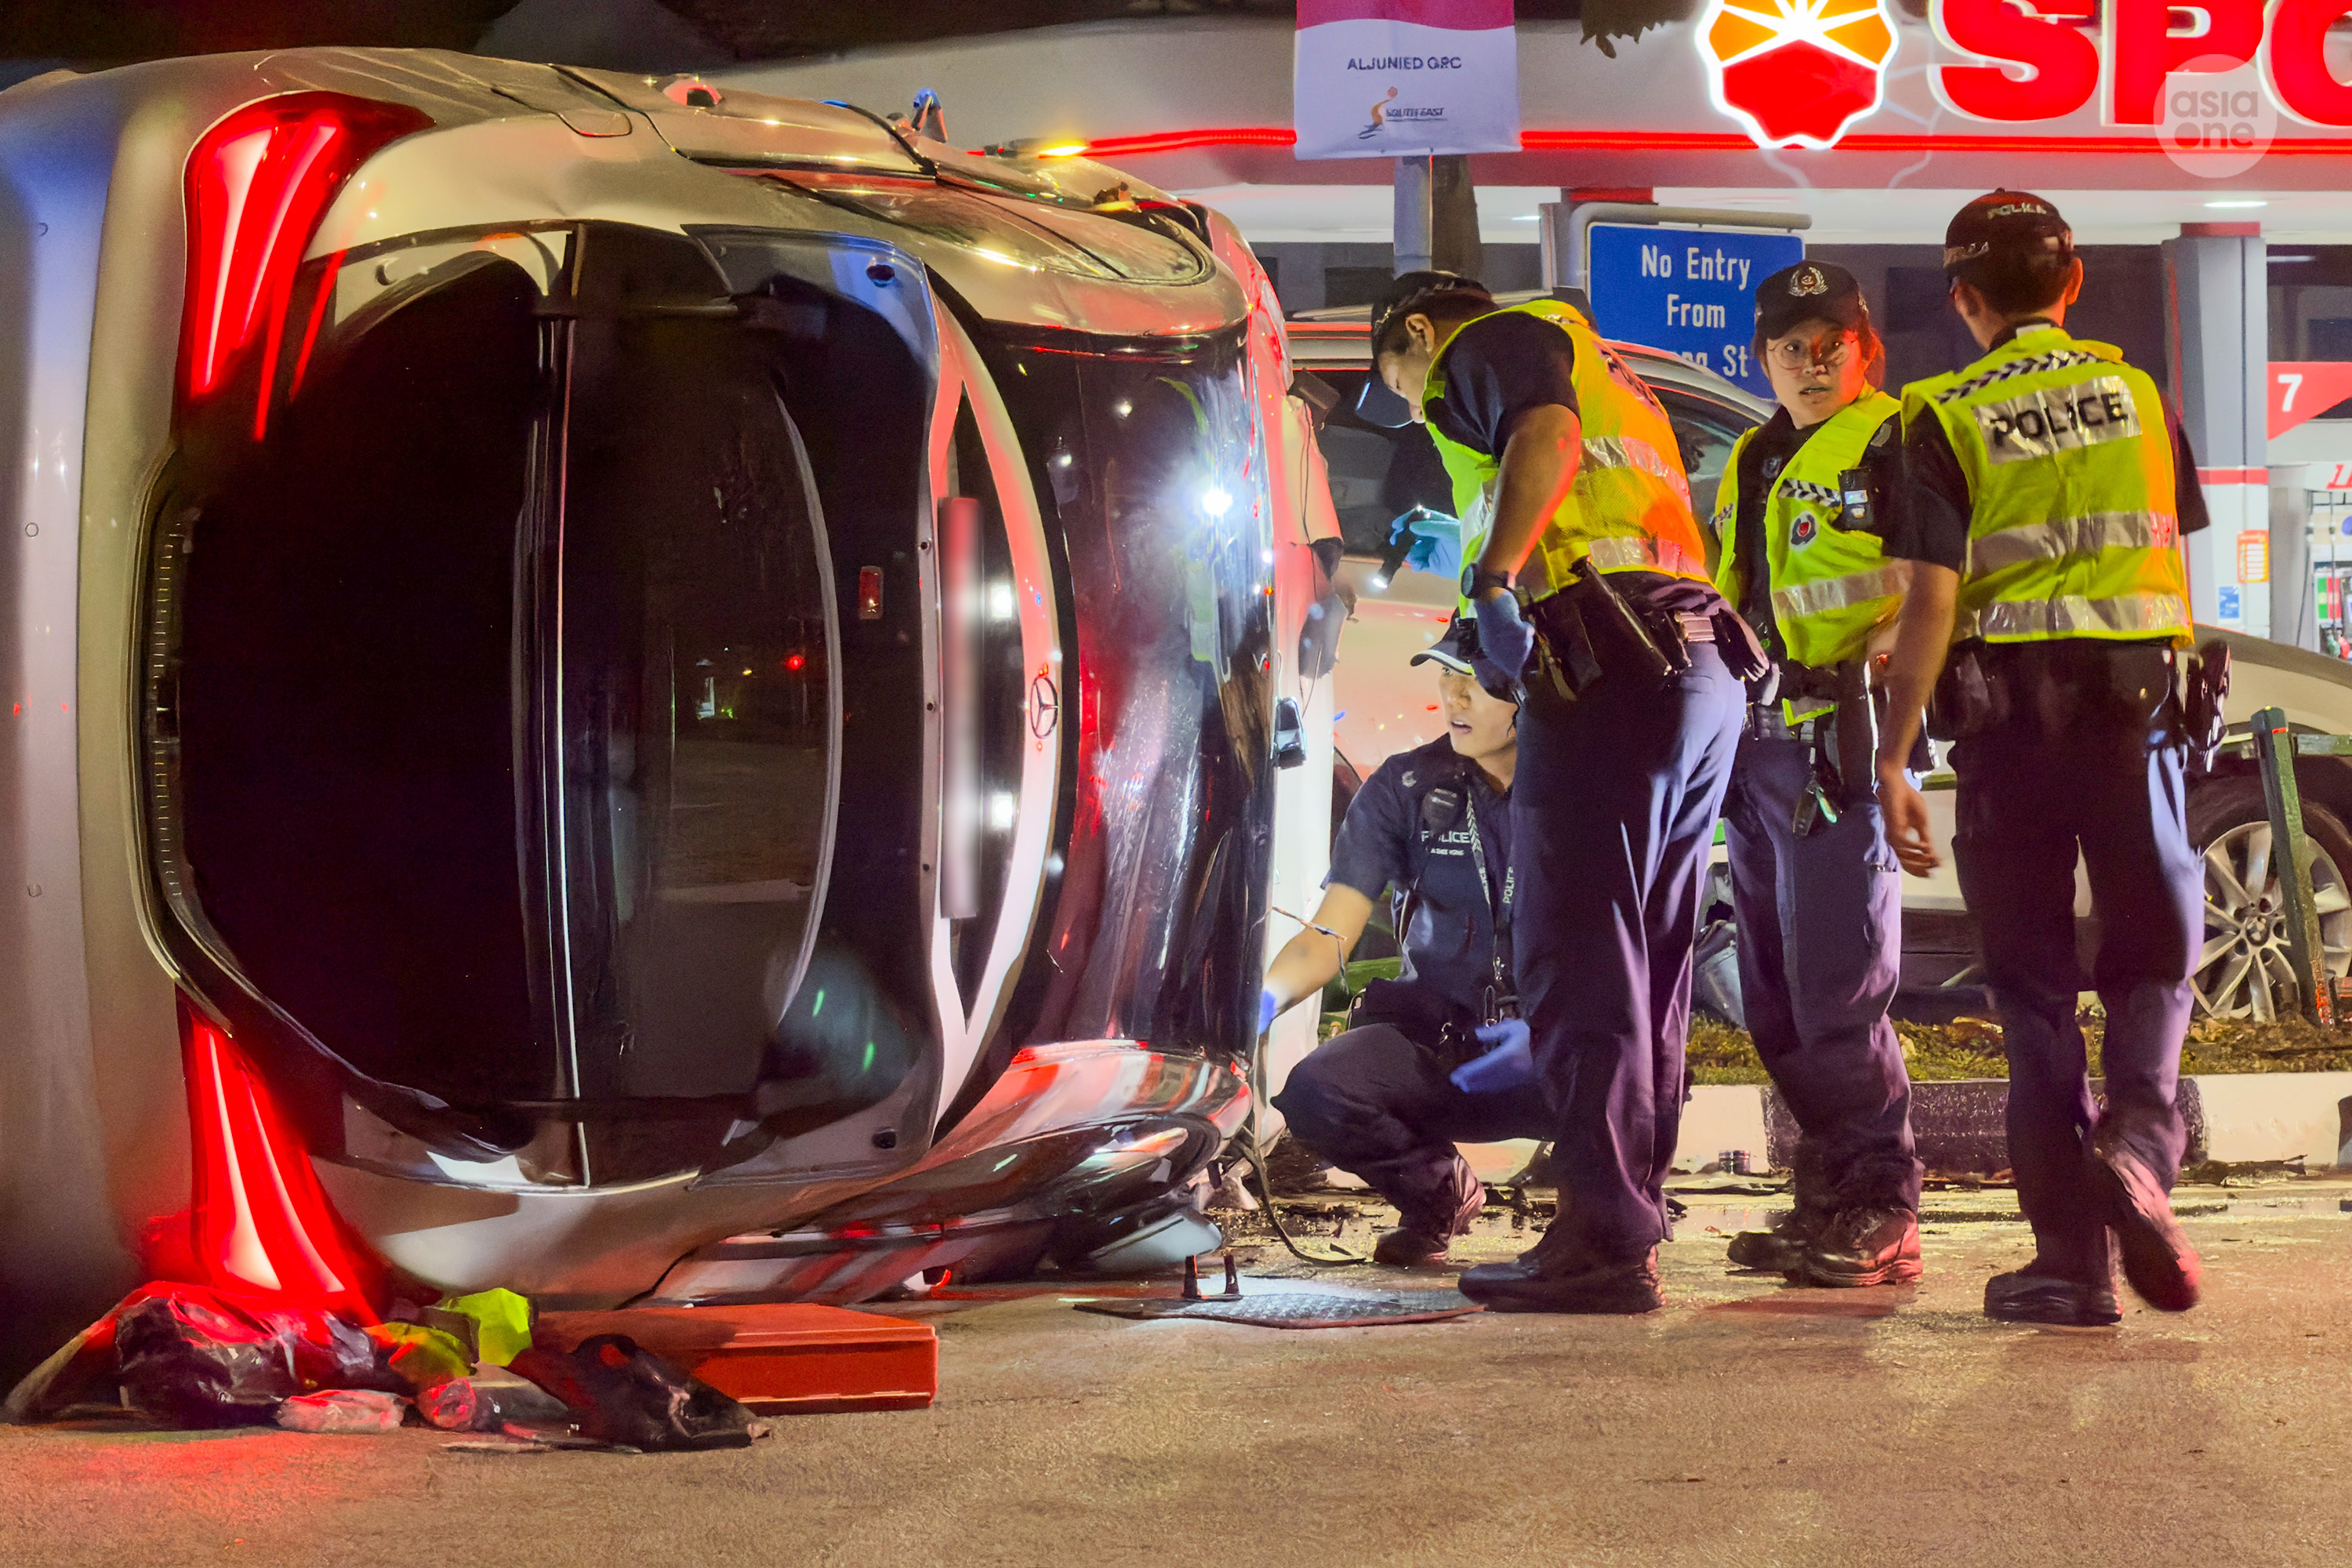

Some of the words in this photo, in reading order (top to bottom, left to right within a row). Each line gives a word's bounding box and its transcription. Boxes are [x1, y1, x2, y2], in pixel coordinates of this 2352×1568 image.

[1347, 56, 1424, 71] ALJUNIED
[1427, 56, 1462, 71] GRC
[1642, 244, 1671, 278] No
[1687, 247, 1751, 291] Entry
[1667, 293, 1725, 328] From
[1722, 344, 1749, 377] St
[2278, 374, 2303, 412] 7
[1989, 392, 2129, 447] POLICE
[1421, 830, 1471, 844] PLICE
